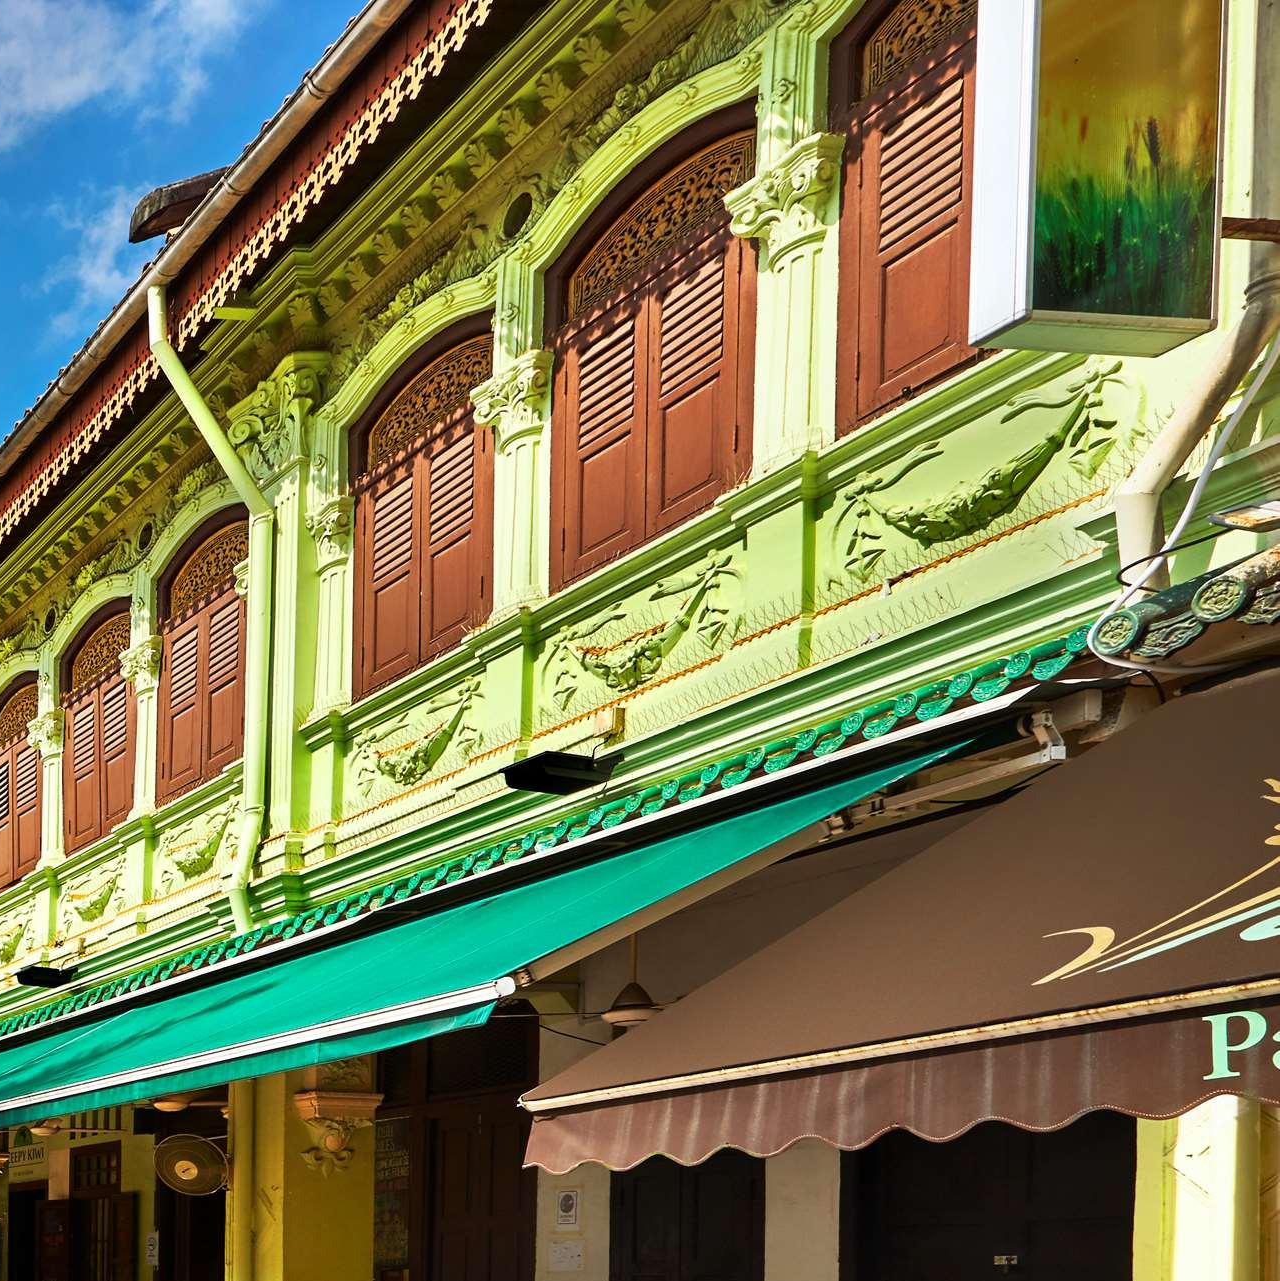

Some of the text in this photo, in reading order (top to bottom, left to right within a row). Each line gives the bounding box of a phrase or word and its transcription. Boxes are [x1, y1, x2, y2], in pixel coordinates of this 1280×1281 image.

[1202, 1010, 1280, 1081] P
[9, 1146, 45, 1164] EEPY KIWI
